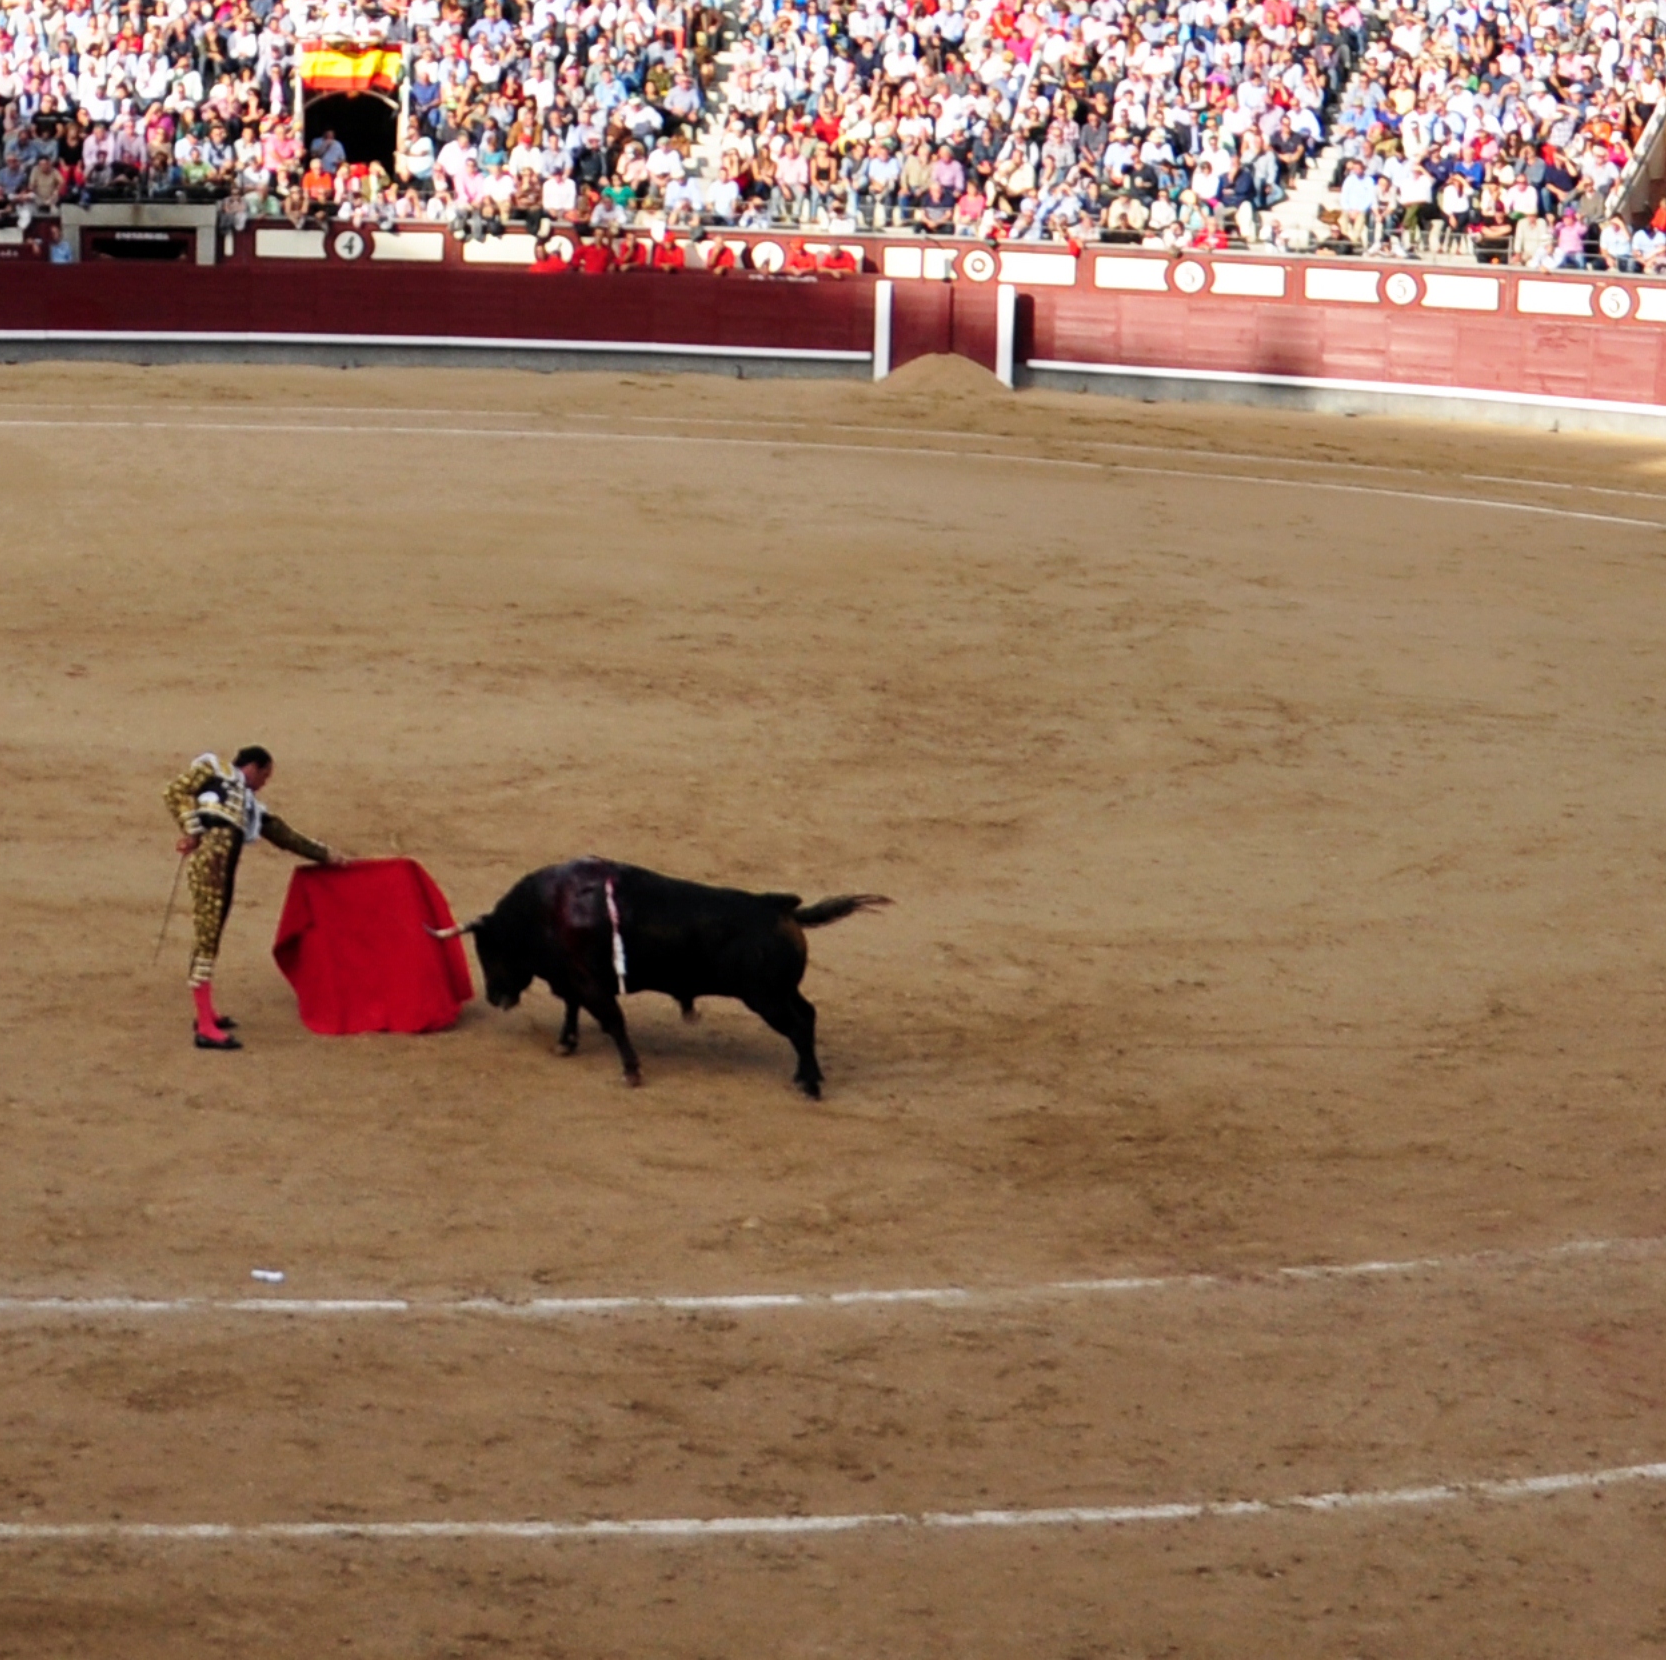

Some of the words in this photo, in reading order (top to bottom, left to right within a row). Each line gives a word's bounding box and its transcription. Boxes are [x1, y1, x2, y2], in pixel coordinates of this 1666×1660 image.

[343, 238, 355, 255] 4
[1185, 267, 1195, 286] 5
[1396, 278, 1407, 299] 5
[1607, 295, 1621, 314] 5
